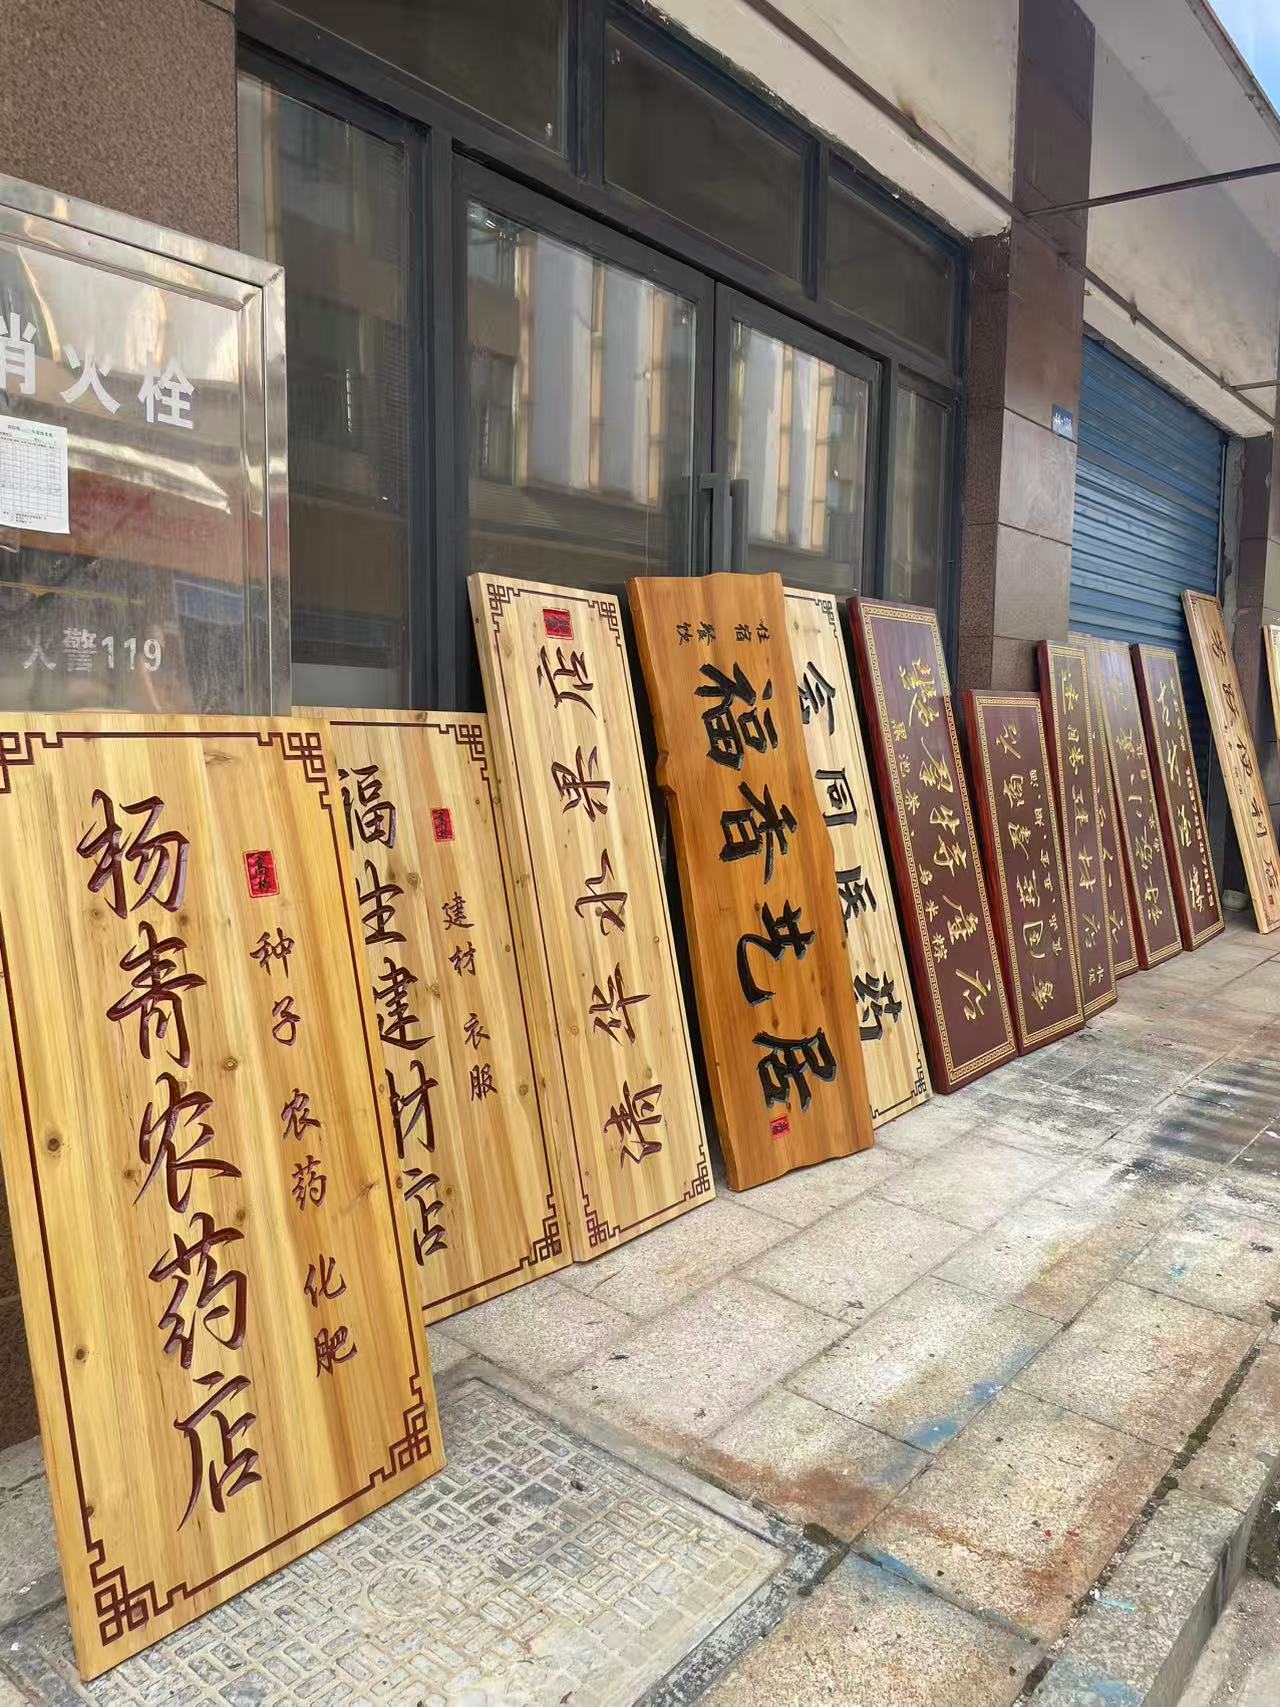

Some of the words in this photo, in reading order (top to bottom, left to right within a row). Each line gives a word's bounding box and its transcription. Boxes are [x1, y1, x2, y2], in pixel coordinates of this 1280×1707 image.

[0, 311, 195, 430] 消火栓
[250, 928, 301, 1046] 种子
[536, 645, 663, 1169] 清华水果店
[694, 661, 837, 1112] 福香艺居
[338, 764, 448, 1266] 福生建材店
[441, 892, 477, 976] 建材
[464, 1012, 498, 1101] 衣服
[77, 789, 262, 1532] 杨青农药店
[280, 1088, 327, 1211] 农药
[302, 1253, 358, 1378] 化肥
